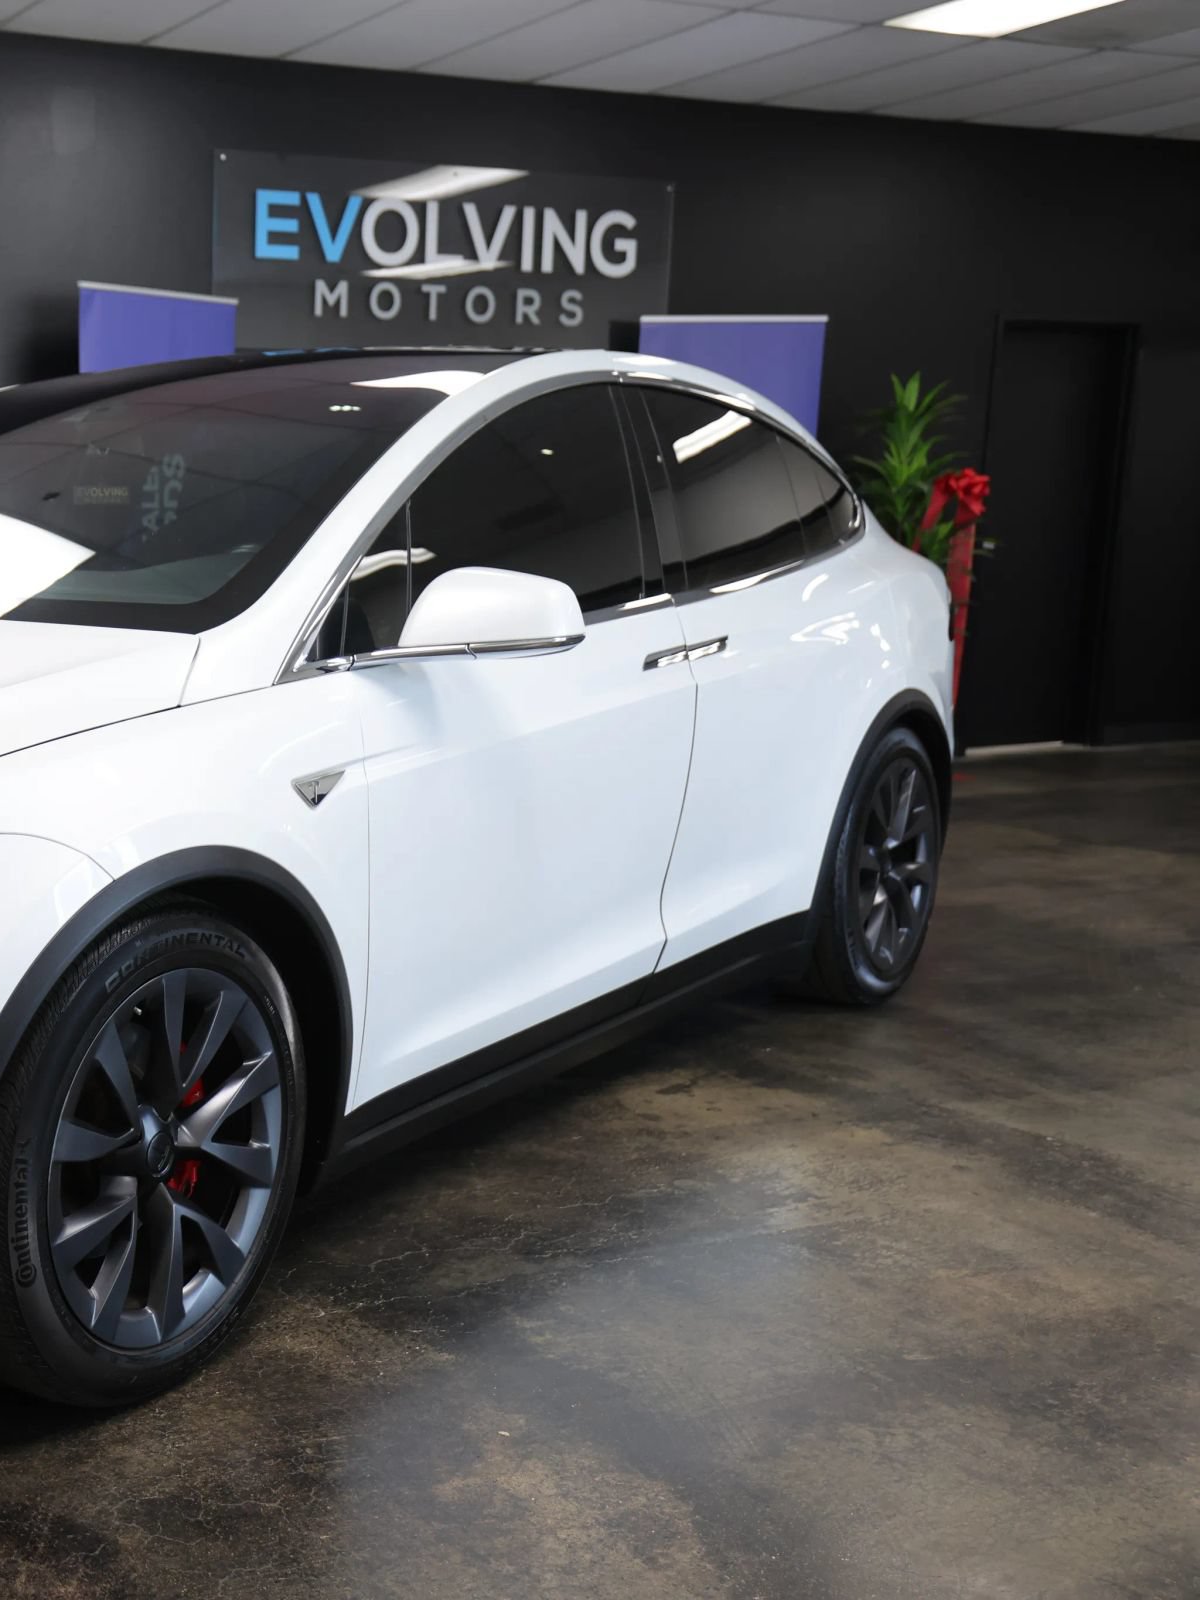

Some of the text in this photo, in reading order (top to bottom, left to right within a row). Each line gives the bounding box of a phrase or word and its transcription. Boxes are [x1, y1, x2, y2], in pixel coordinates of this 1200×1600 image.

[254, 188, 638, 278] EVOLVING
[313, 279, 584, 327] MOTORS
[12, 1157, 37, 1289] Continental
